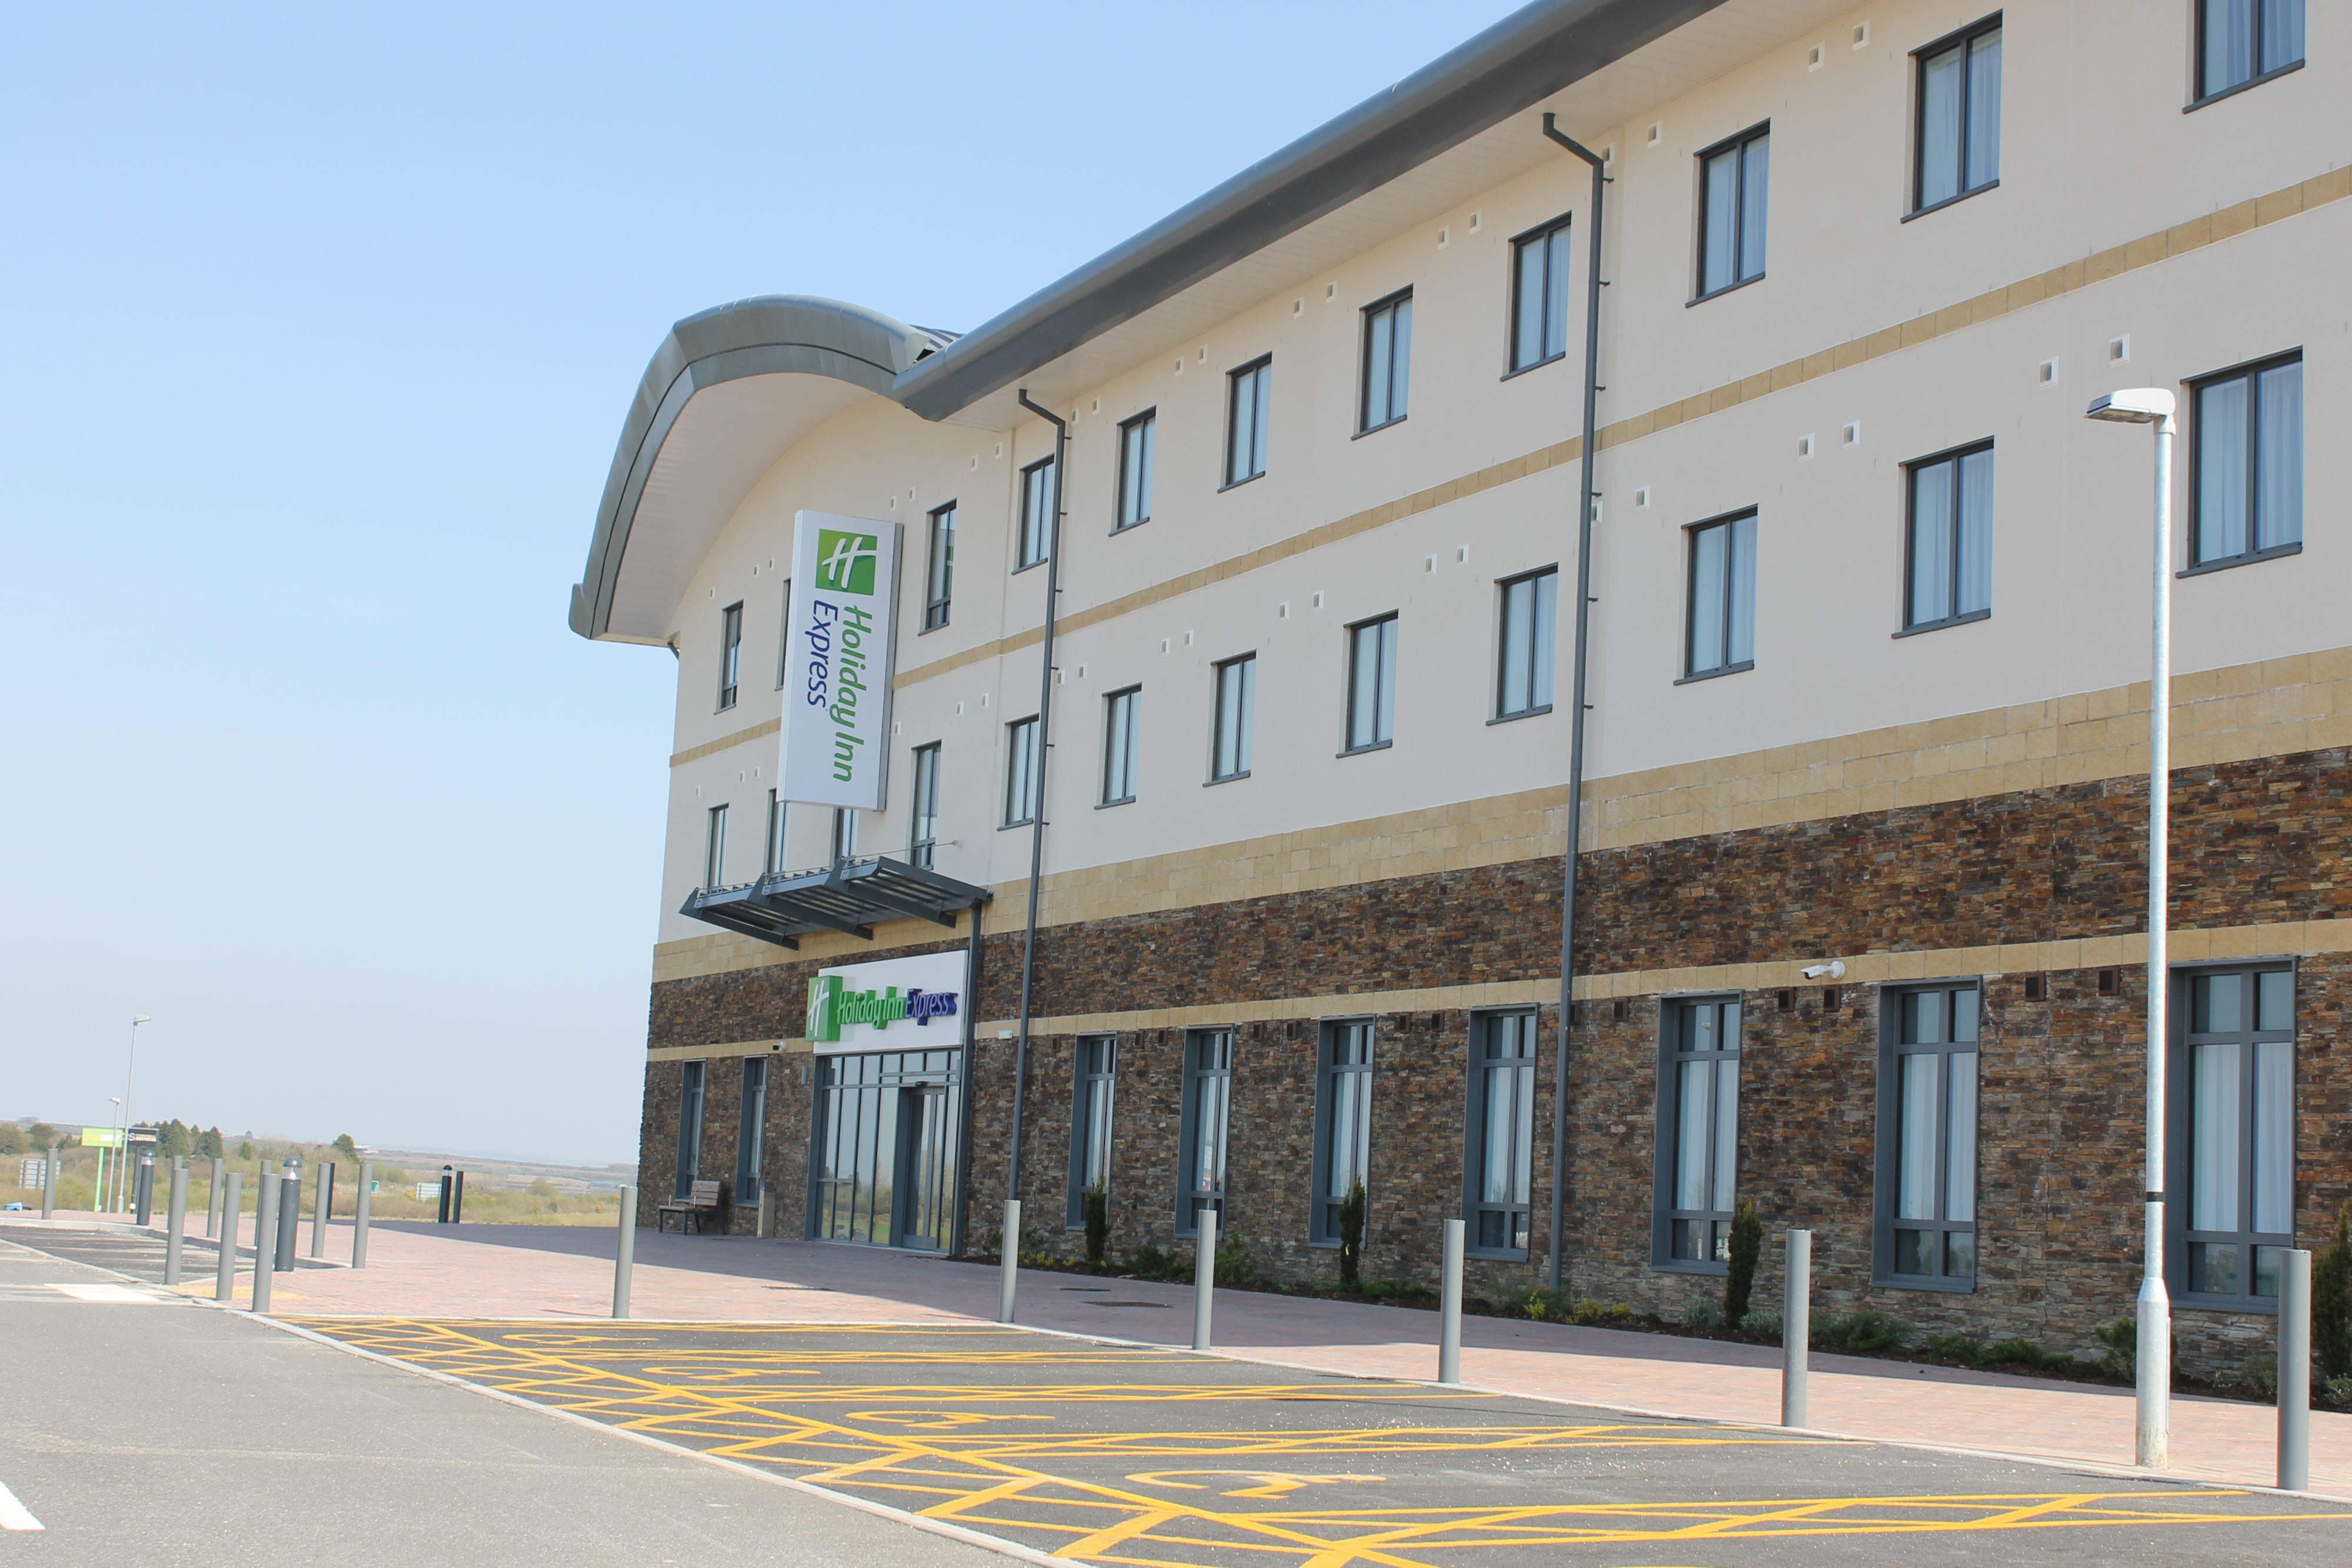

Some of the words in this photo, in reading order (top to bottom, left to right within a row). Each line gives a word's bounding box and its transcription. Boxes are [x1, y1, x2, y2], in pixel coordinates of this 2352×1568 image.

[804, 599, 838, 708] Express
[829, 605, 873, 728] Holiday
[833, 731, 864, 783] Inn
[837, 989, 883, 1029] Holiday
[883, 985, 905, 1020] Inn
[906, 988, 952, 1026] Express
